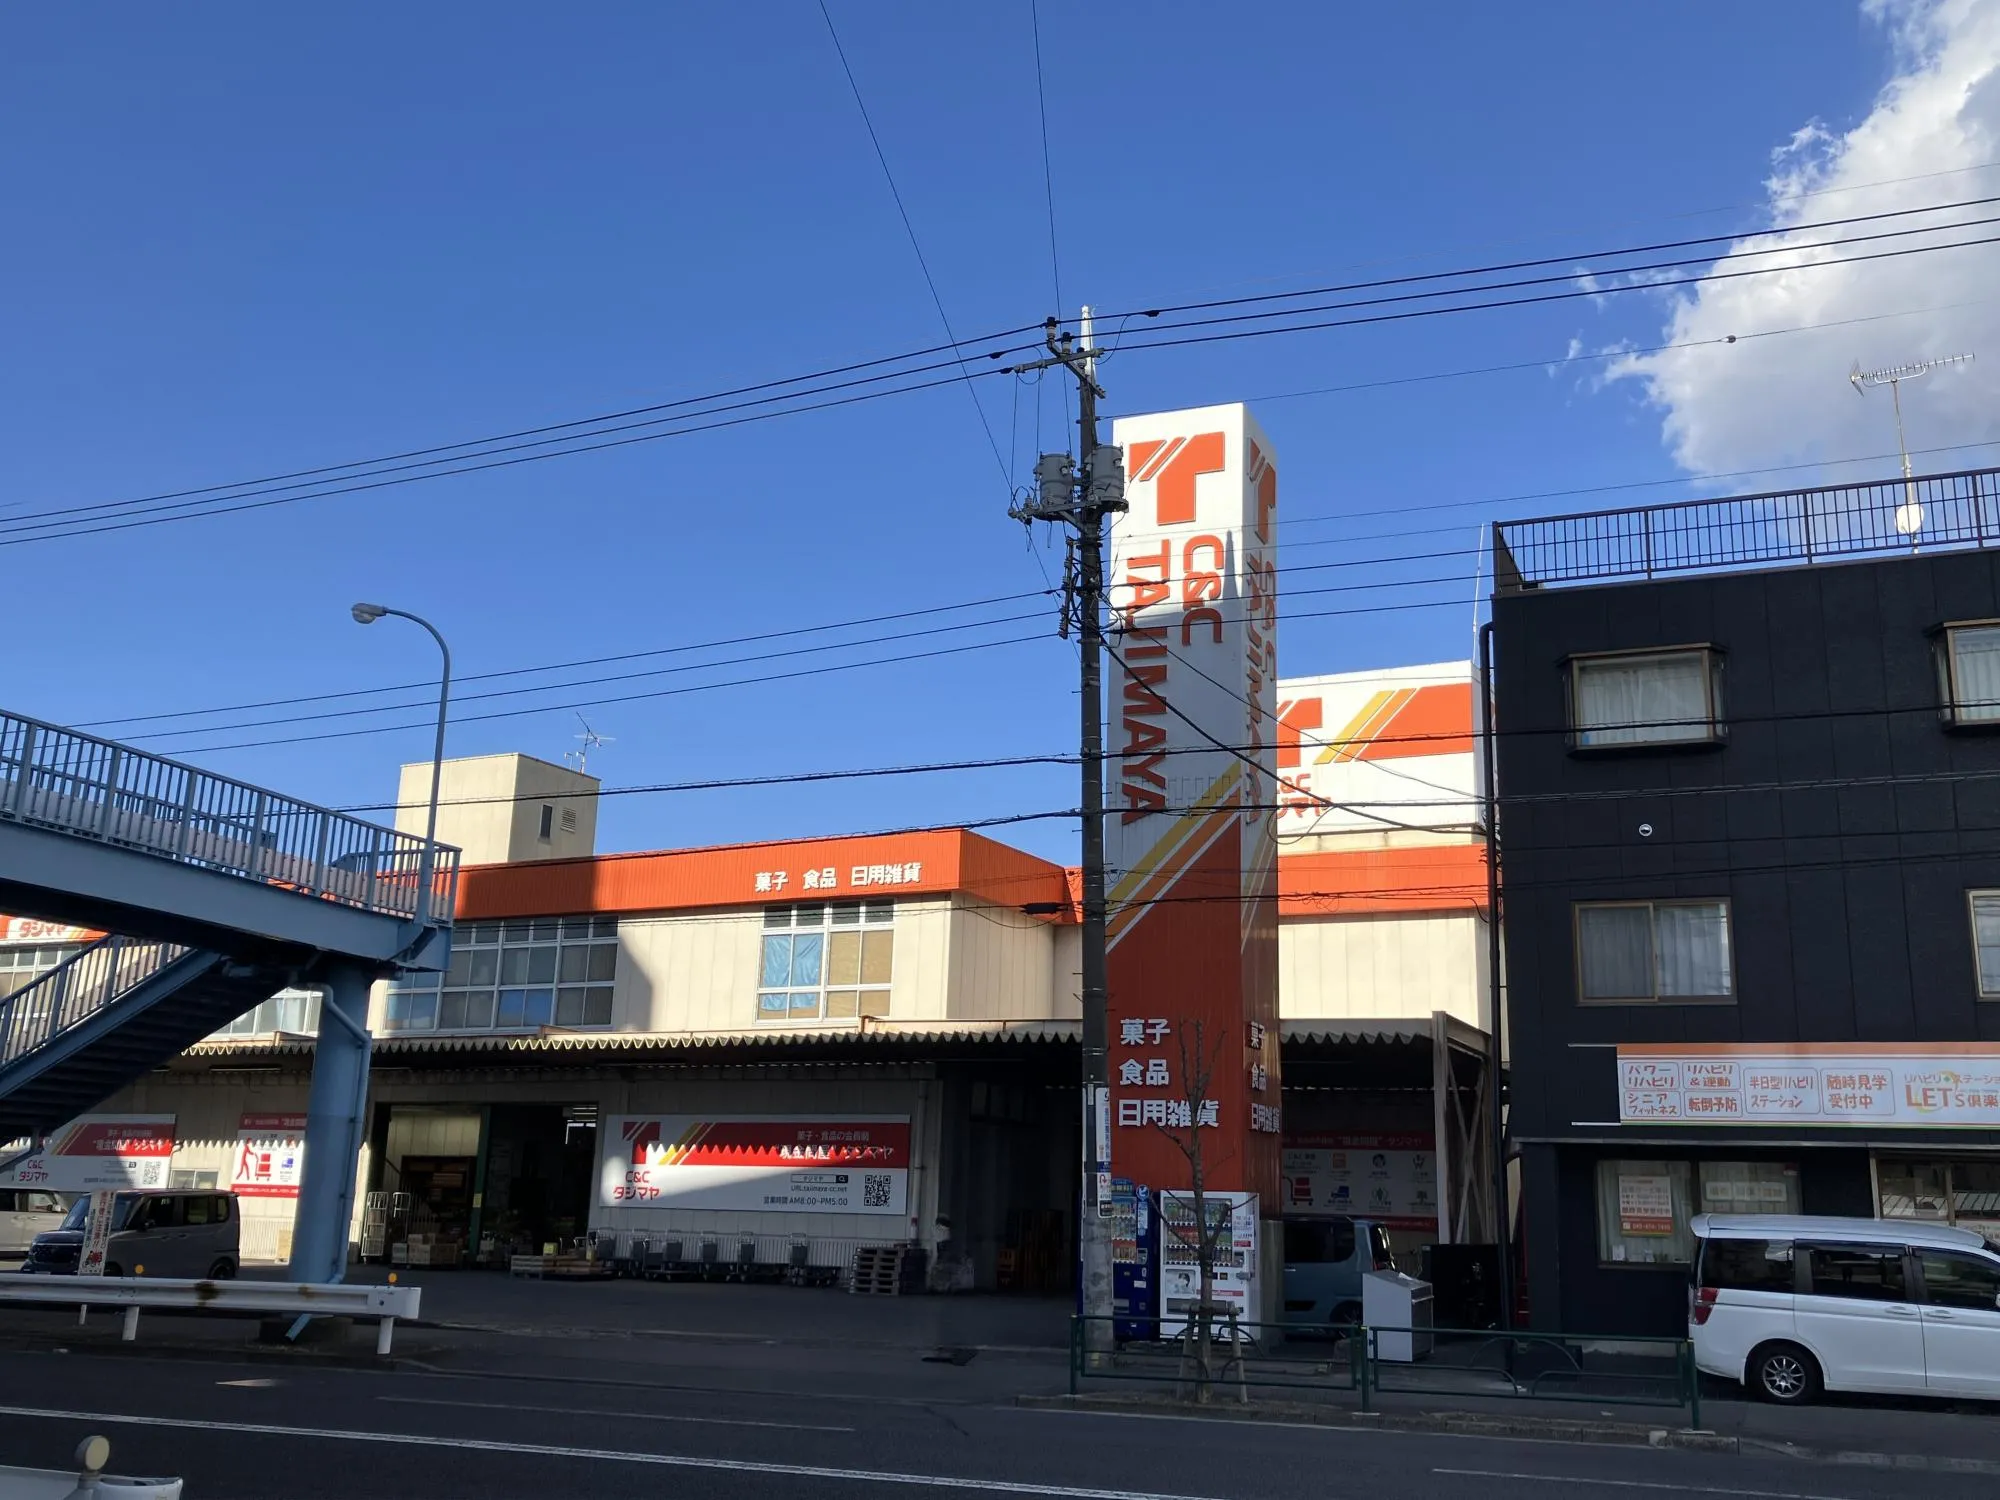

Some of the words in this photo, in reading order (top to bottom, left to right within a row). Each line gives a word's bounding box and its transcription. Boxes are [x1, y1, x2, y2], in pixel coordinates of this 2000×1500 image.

[1181, 534, 1225, 646] C&C
[1121, 538, 1172, 825] TAJIMAYA
[755, 871, 789, 892] 菓子
[803, 867, 837, 890] 食品
[851, 862, 922, 887] 日用雑貨
[1120, 1018, 1171, 1046] 菓子
[1249, 1021, 1266, 1050] 菓子
[1119, 1059, 1170, 1086] 食品
[1250, 1062, 1267, 1092] 食品
[1628, 1064, 1672, 1074] パワー
[1687, 1064, 1733, 1074] リハビリ
[1628, 1076, 1674, 1088] リハビリ
[1749, 1075, 1814, 1090] 半日型リハビリ
[1826, 1074, 1888, 1091] 随時見学
[1628, 1093, 1668, 1104] シニア
[1688, 1096, 1738, 1112] 転倒予防
[1751, 1095, 1803, 1108] ステーション
[1828, 1093, 1873, 1109] 受付中
[1118, 1099, 1219, 1128] 日用雑貨
[1250, 1103, 1280, 1134] 日用雑貨
[1629, 1105, 1677, 1116] フィットネス
[844, 1144, 894, 1160] タジマヤ
[19, 1171, 49, 1182] タジマヤ
[625, 1170, 650, 1184] C&C
[612, 1185, 660, 1201] タジマヤ
